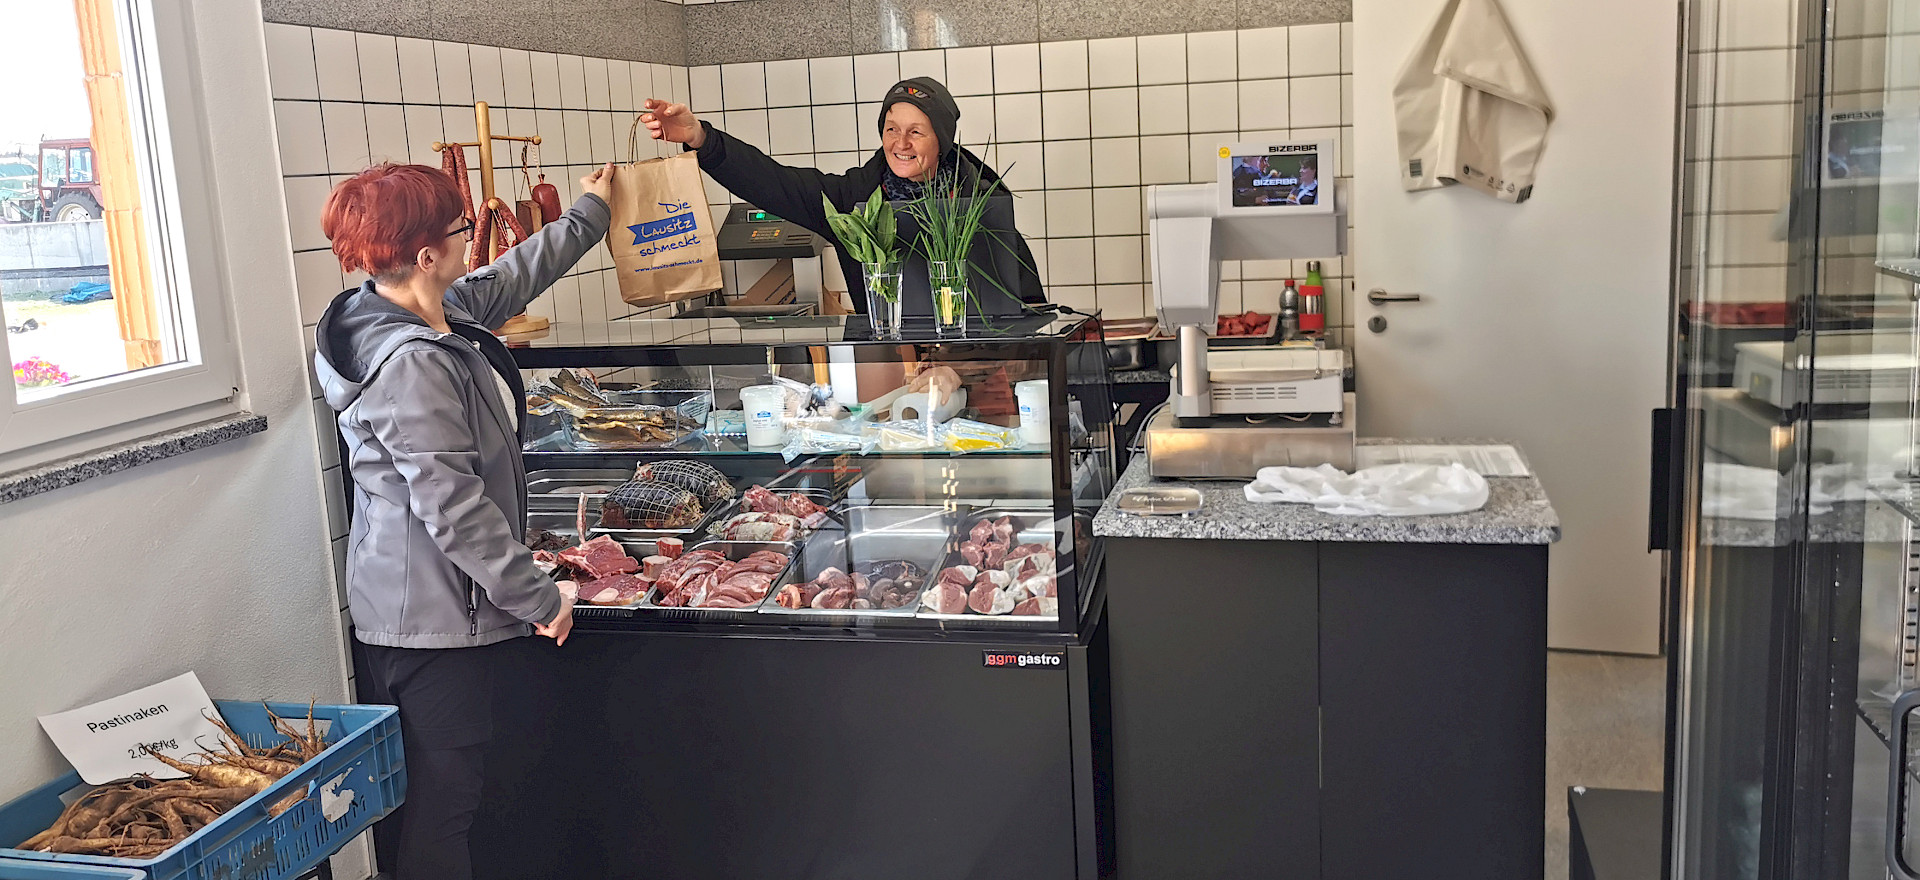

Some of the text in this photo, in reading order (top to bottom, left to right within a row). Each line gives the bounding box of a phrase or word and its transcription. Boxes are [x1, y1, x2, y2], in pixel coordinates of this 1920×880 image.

[1268, 144, 1318, 153] BIZERBA
[1253, 178, 1298, 187] BIZERBA
[658, 199, 692, 214] Die
[639, 234, 701, 257] schmeckt
[86, 702, 169, 734] Pastinaken
